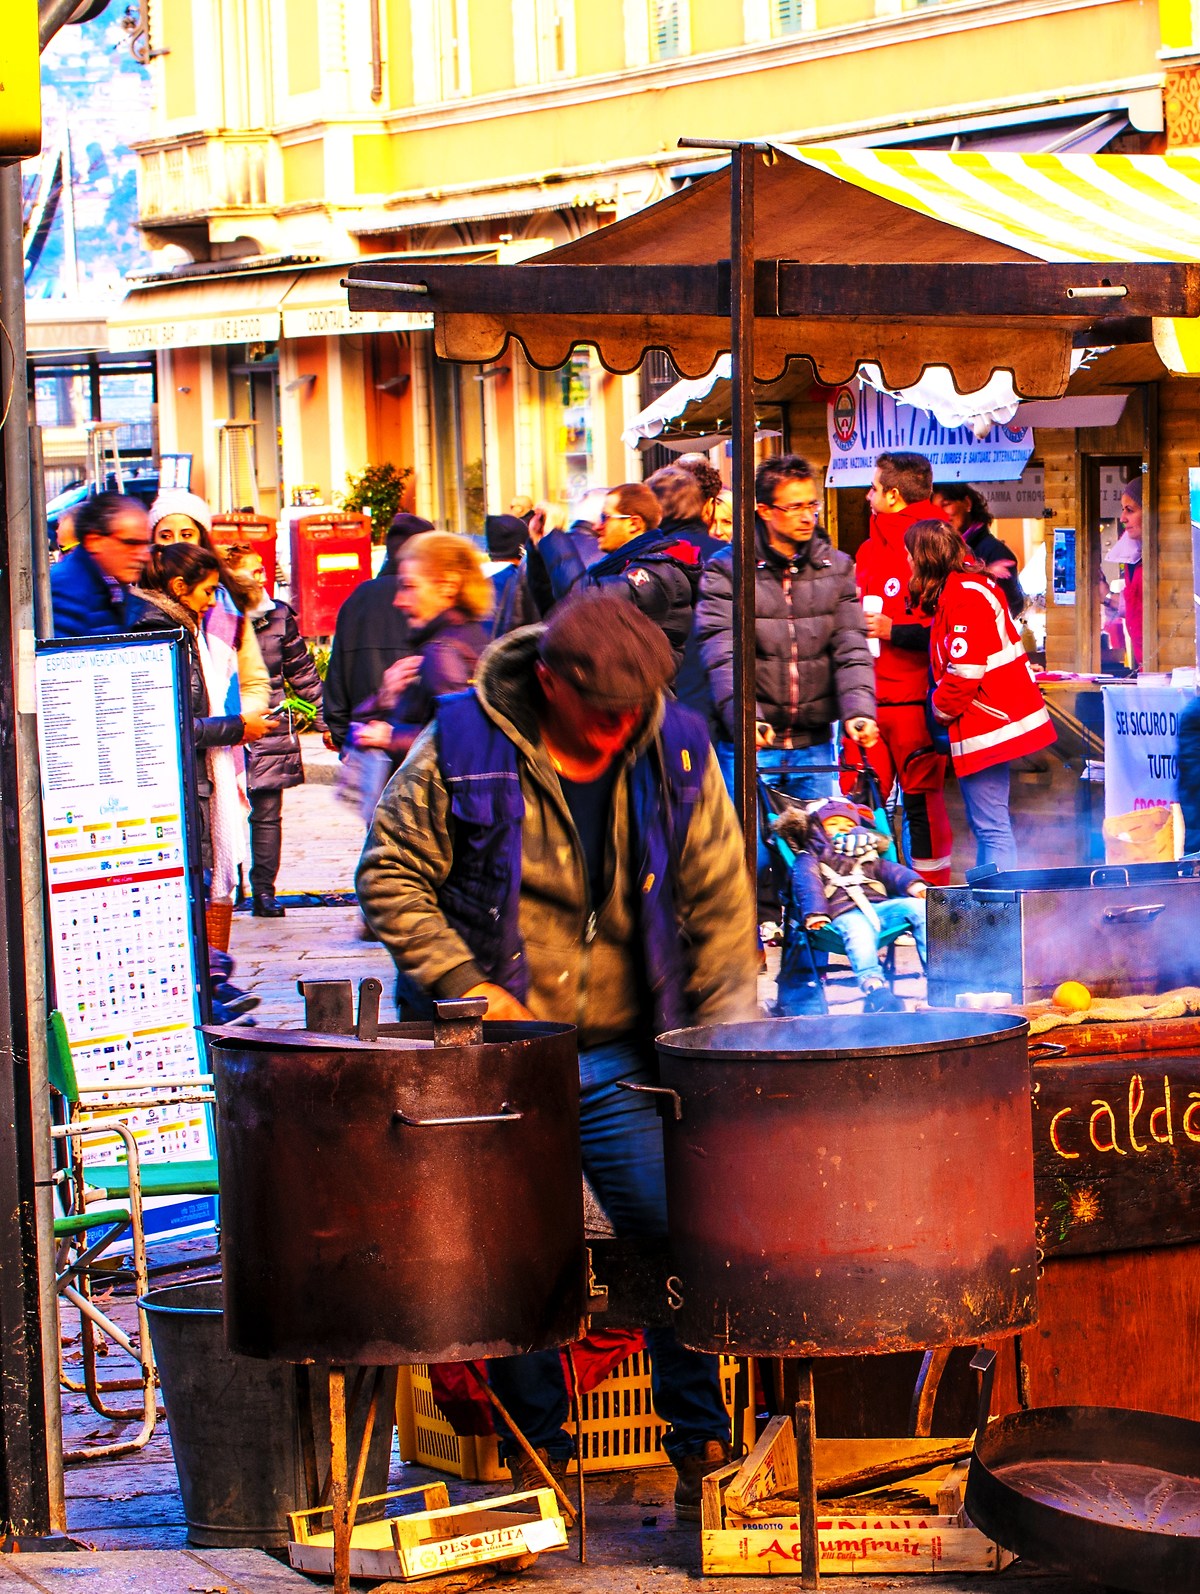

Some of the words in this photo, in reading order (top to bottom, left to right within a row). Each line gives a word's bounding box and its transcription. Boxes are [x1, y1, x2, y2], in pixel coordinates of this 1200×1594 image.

[225, 515, 258, 523] POSTE
[320, 514, 352, 523] POSTE
[1116, 711, 1130, 736] SEI
[1130, 711, 1167, 736] SICURO
[757, 1537, 922, 1562] Agumfruit
